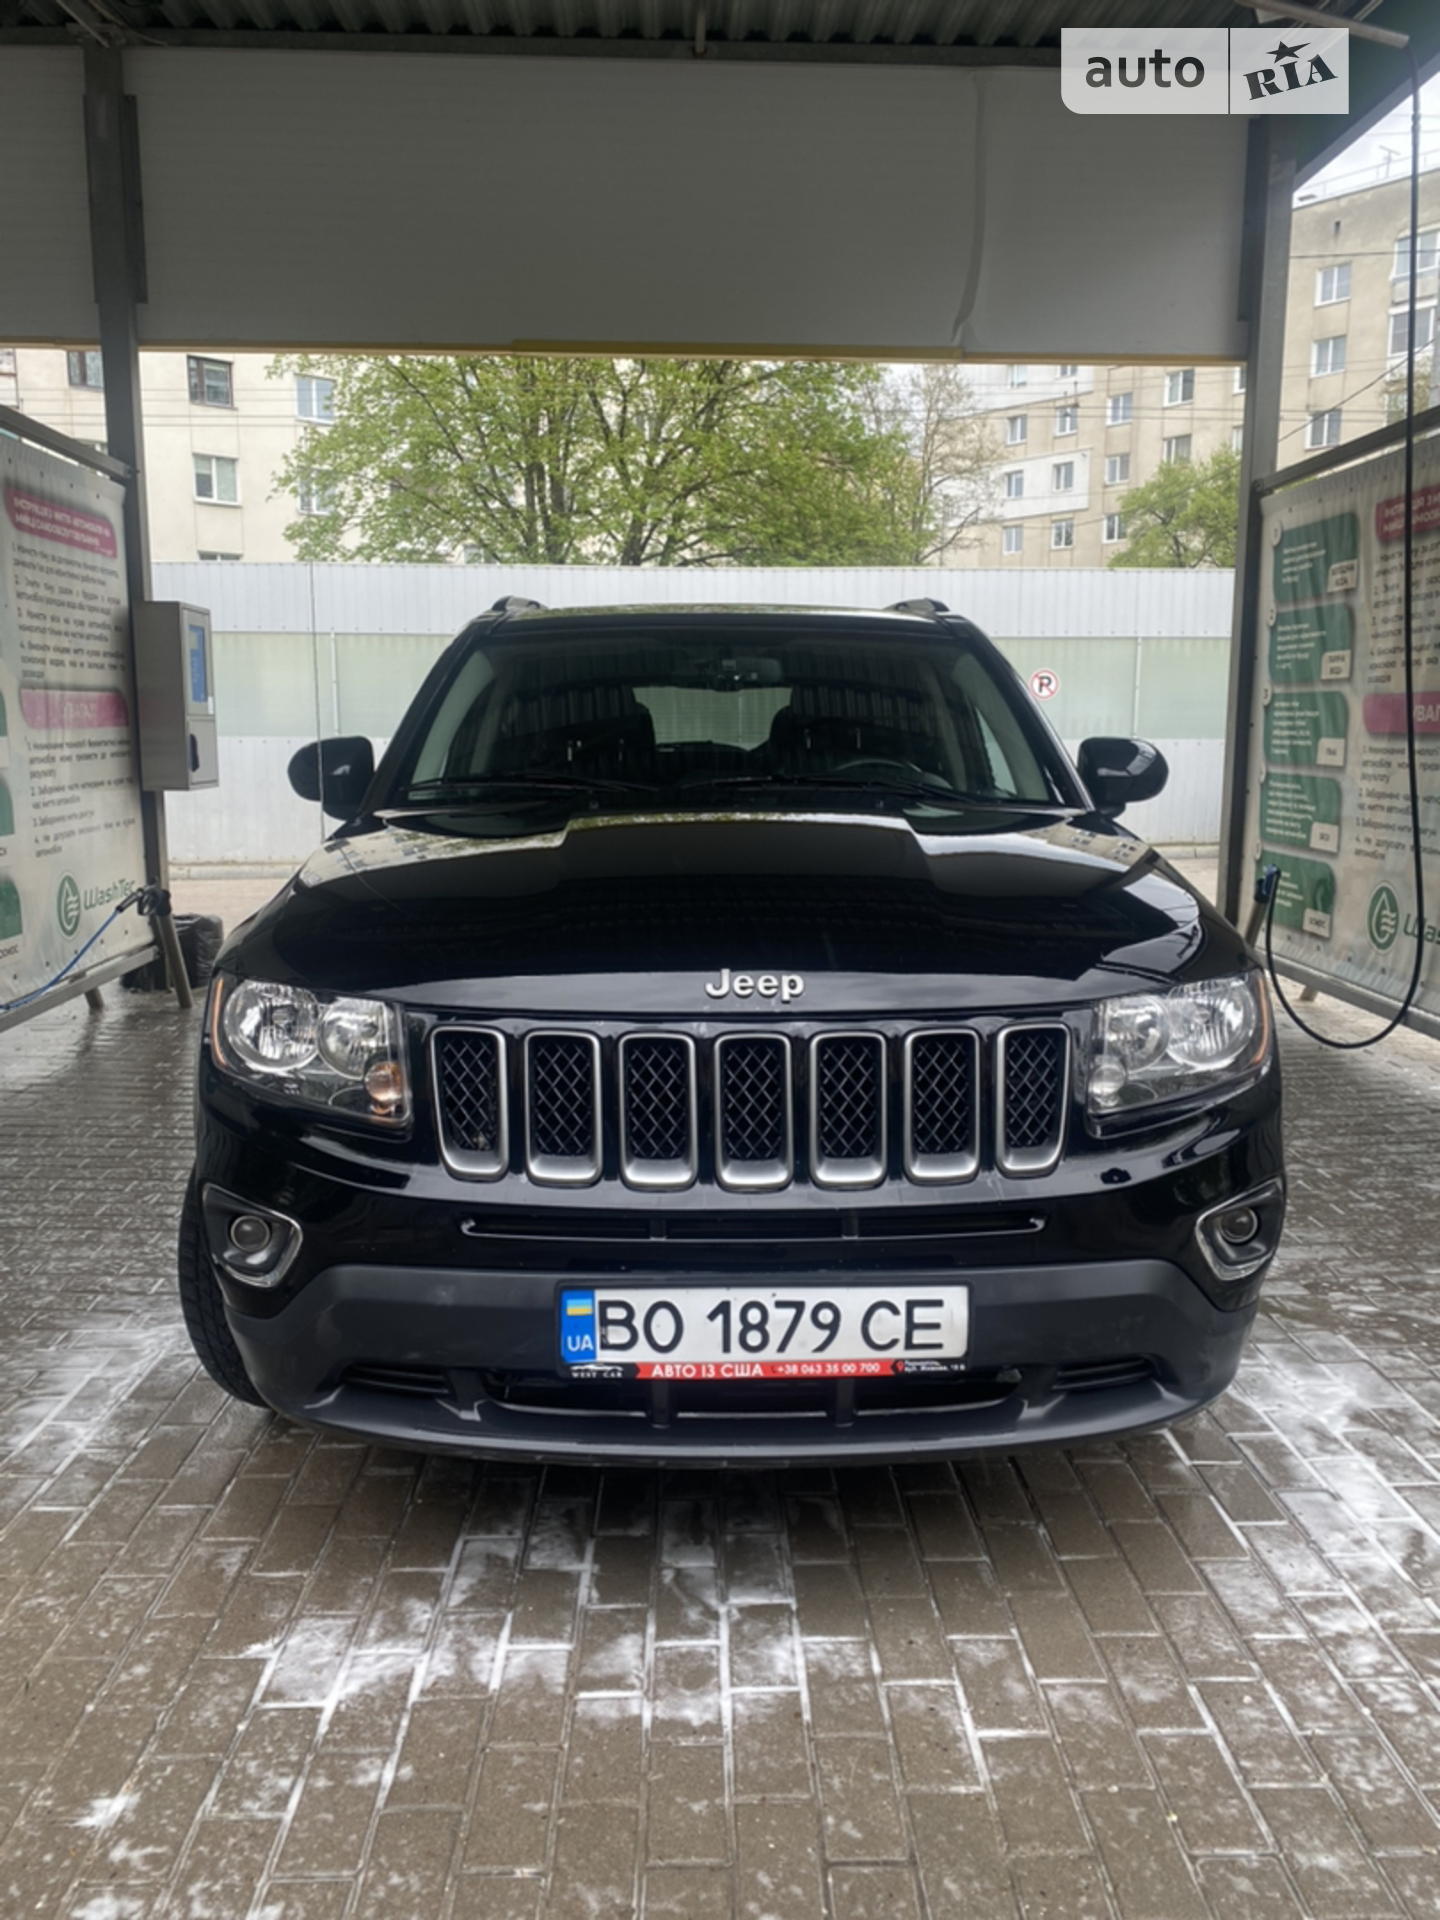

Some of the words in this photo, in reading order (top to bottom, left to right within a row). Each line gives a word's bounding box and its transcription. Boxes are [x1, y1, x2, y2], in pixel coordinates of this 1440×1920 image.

[705, 968, 805, 1001] Jeep
[598, 1299, 685, 1354] BO
[706, 1299, 842, 1354] 1879
[860, 1298, 944, 1352] CE
[567, 1335, 594, 1352] UA
[652, 1363, 697, 1378] АВТО
[720, 1363, 765, 1377] США
[777, 1363, 799, 1375] +38
[800, 1363, 822, 1375] 063
[825, 1363, 840, 1375] 35
[842, 1362, 858, 1374] 00
[860, 1362, 881, 1374] 700
